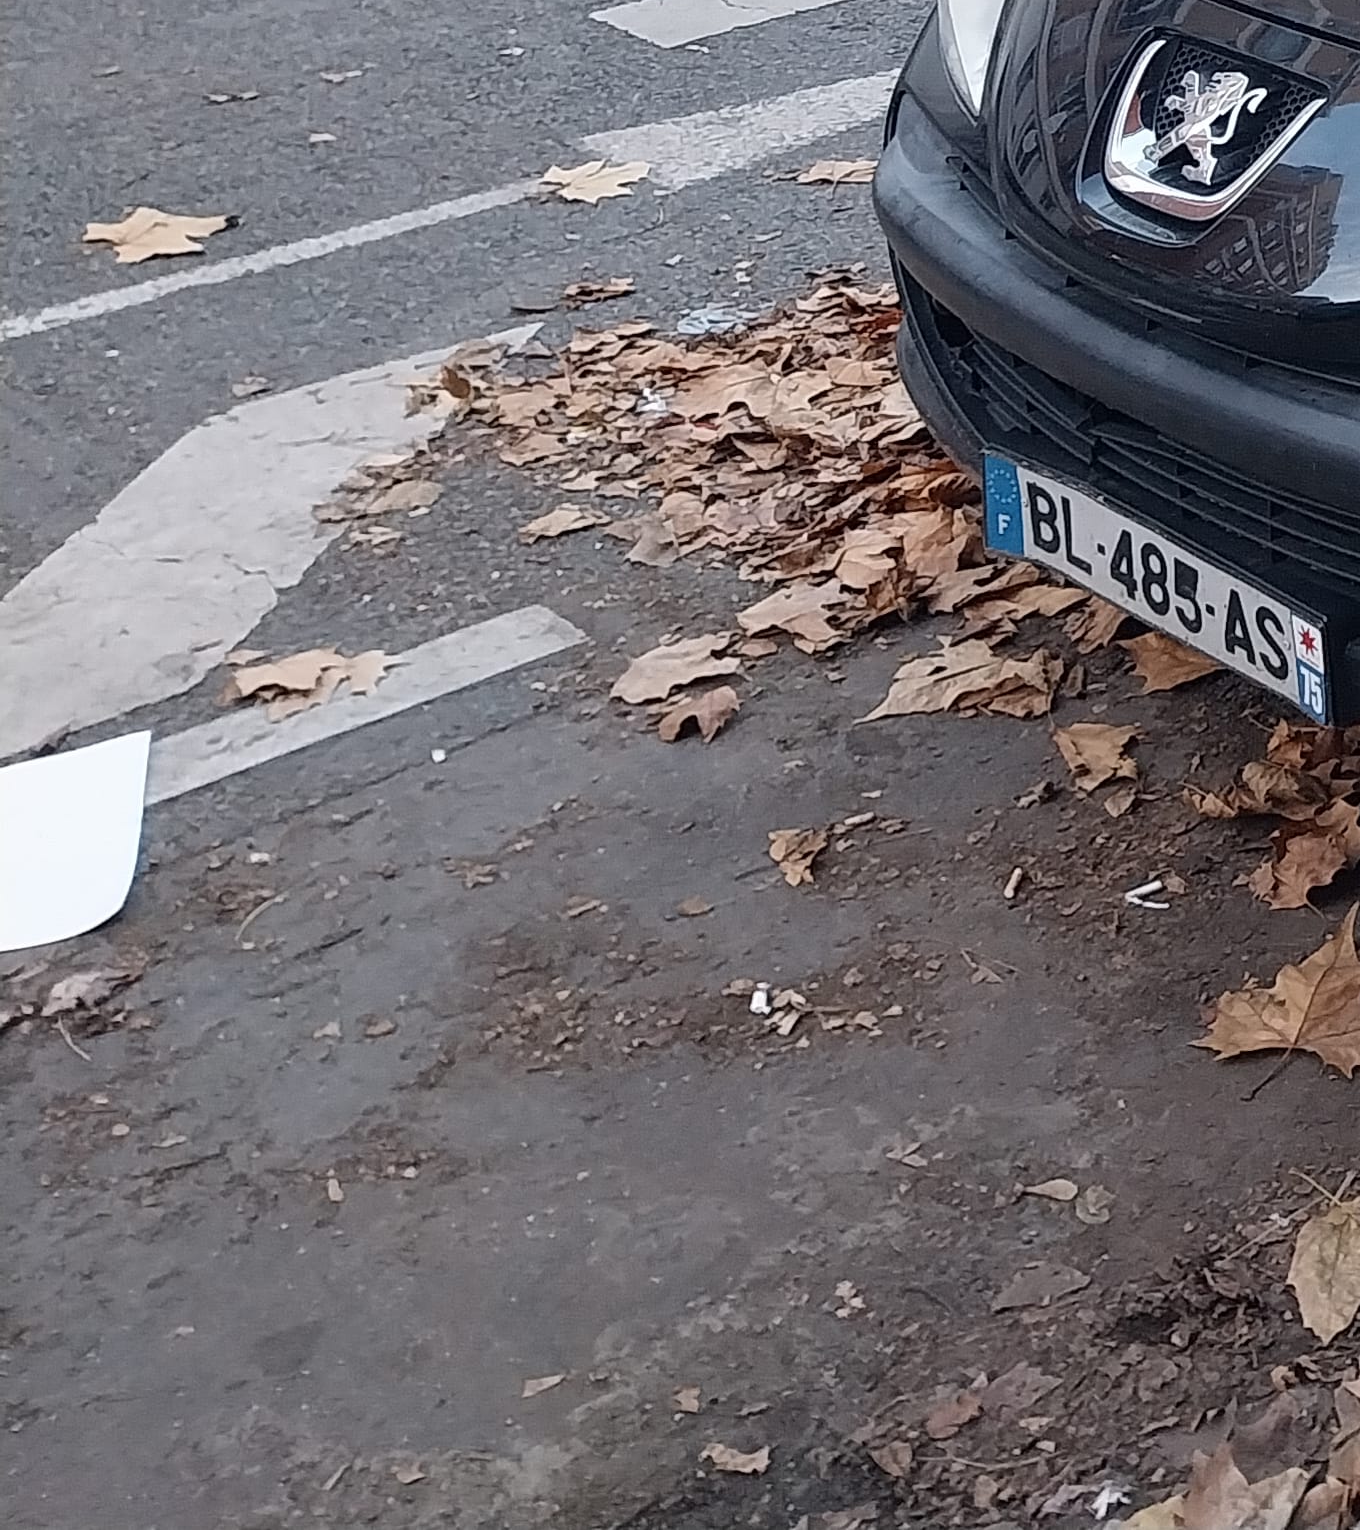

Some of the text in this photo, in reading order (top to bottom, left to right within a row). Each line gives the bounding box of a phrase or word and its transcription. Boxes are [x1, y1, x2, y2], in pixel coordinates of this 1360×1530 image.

[998, 513, 1011, 535] F
[1026, 481, 1290, 681] BL-485-AS
[1300, 664, 1323, 716] 75
